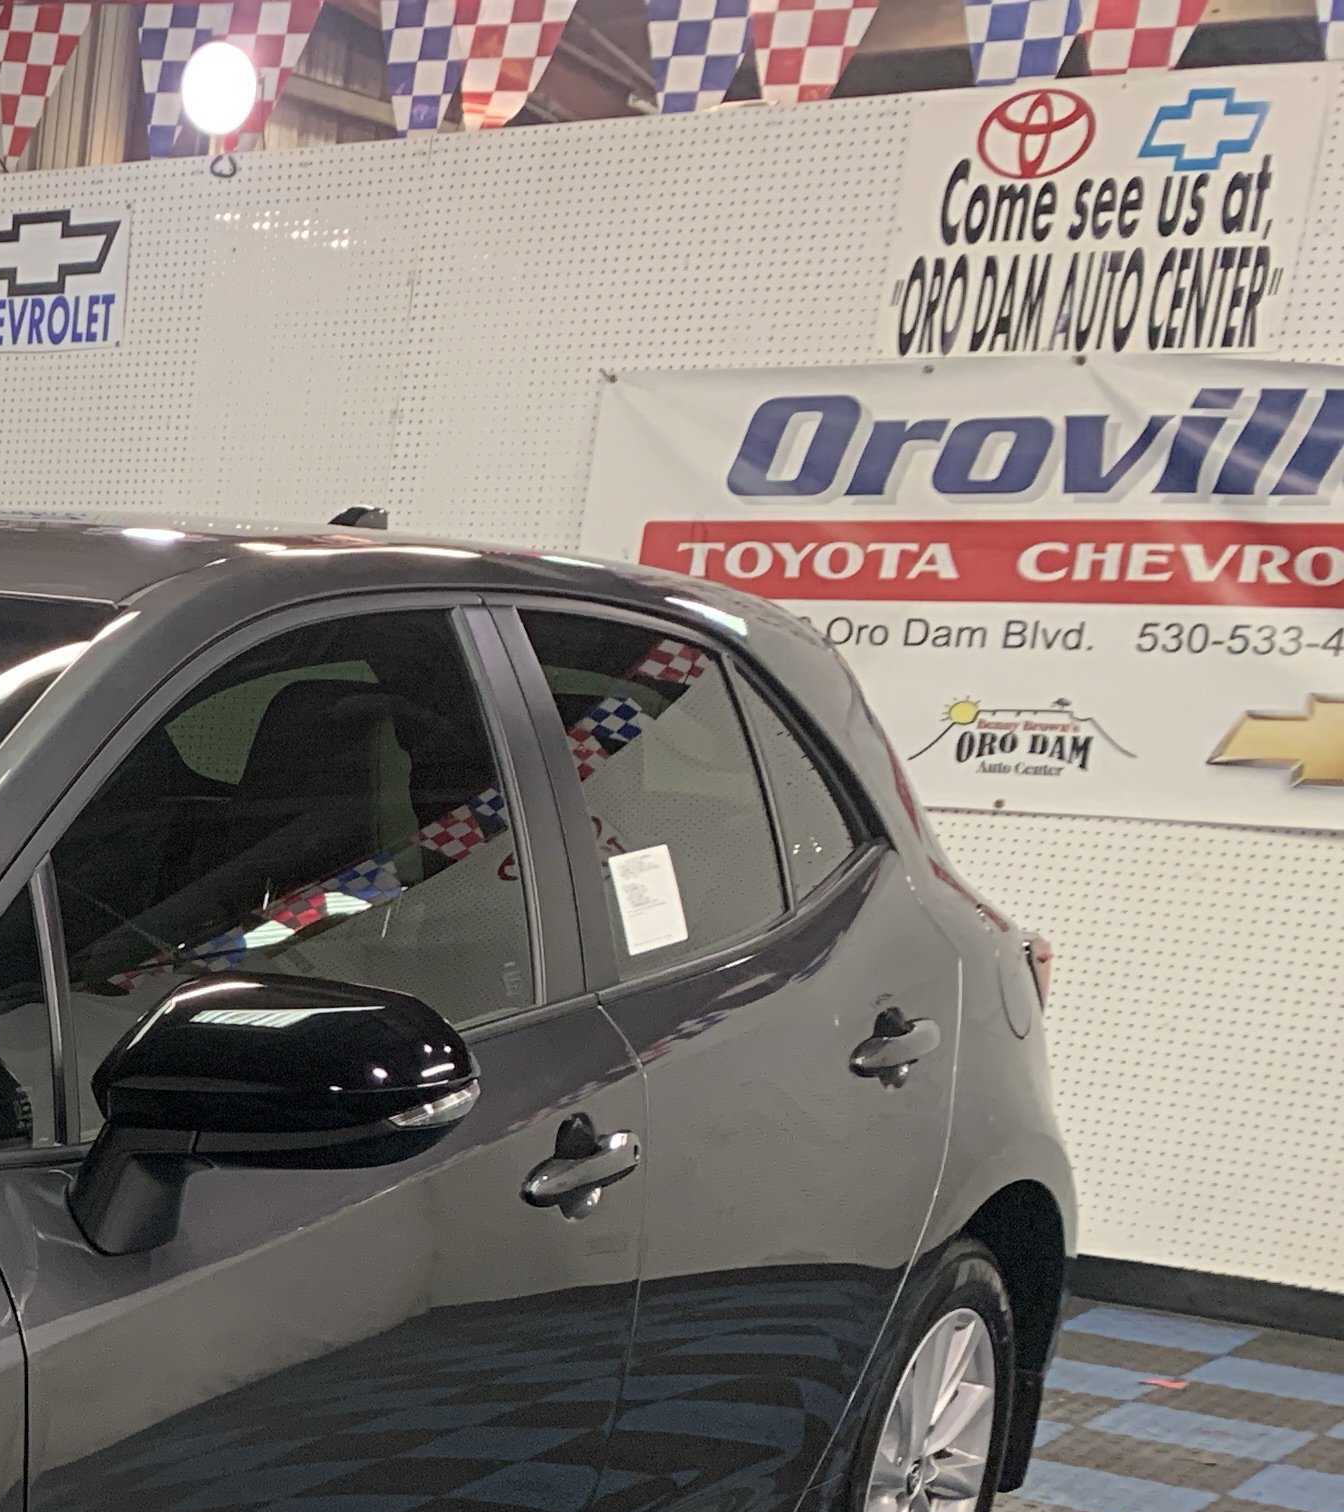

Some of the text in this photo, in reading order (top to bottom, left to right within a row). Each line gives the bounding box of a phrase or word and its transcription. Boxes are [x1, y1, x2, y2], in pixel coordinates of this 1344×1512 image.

[940, 154, 1274, 245] Come see us at,
[890, 247, 1284, 356] "ORO DAM AUTO CENTER"
[727, 388, 1344, 497] Orovill
[676, 540, 1344, 587] TOYOTA CHEVRO
[825, 616, 1344, 657] Oro Dam Blvd. 530-533-4
[955, 731, 1094, 772] ORO DAM
[976, 760, 1065, 776] Auto Center
